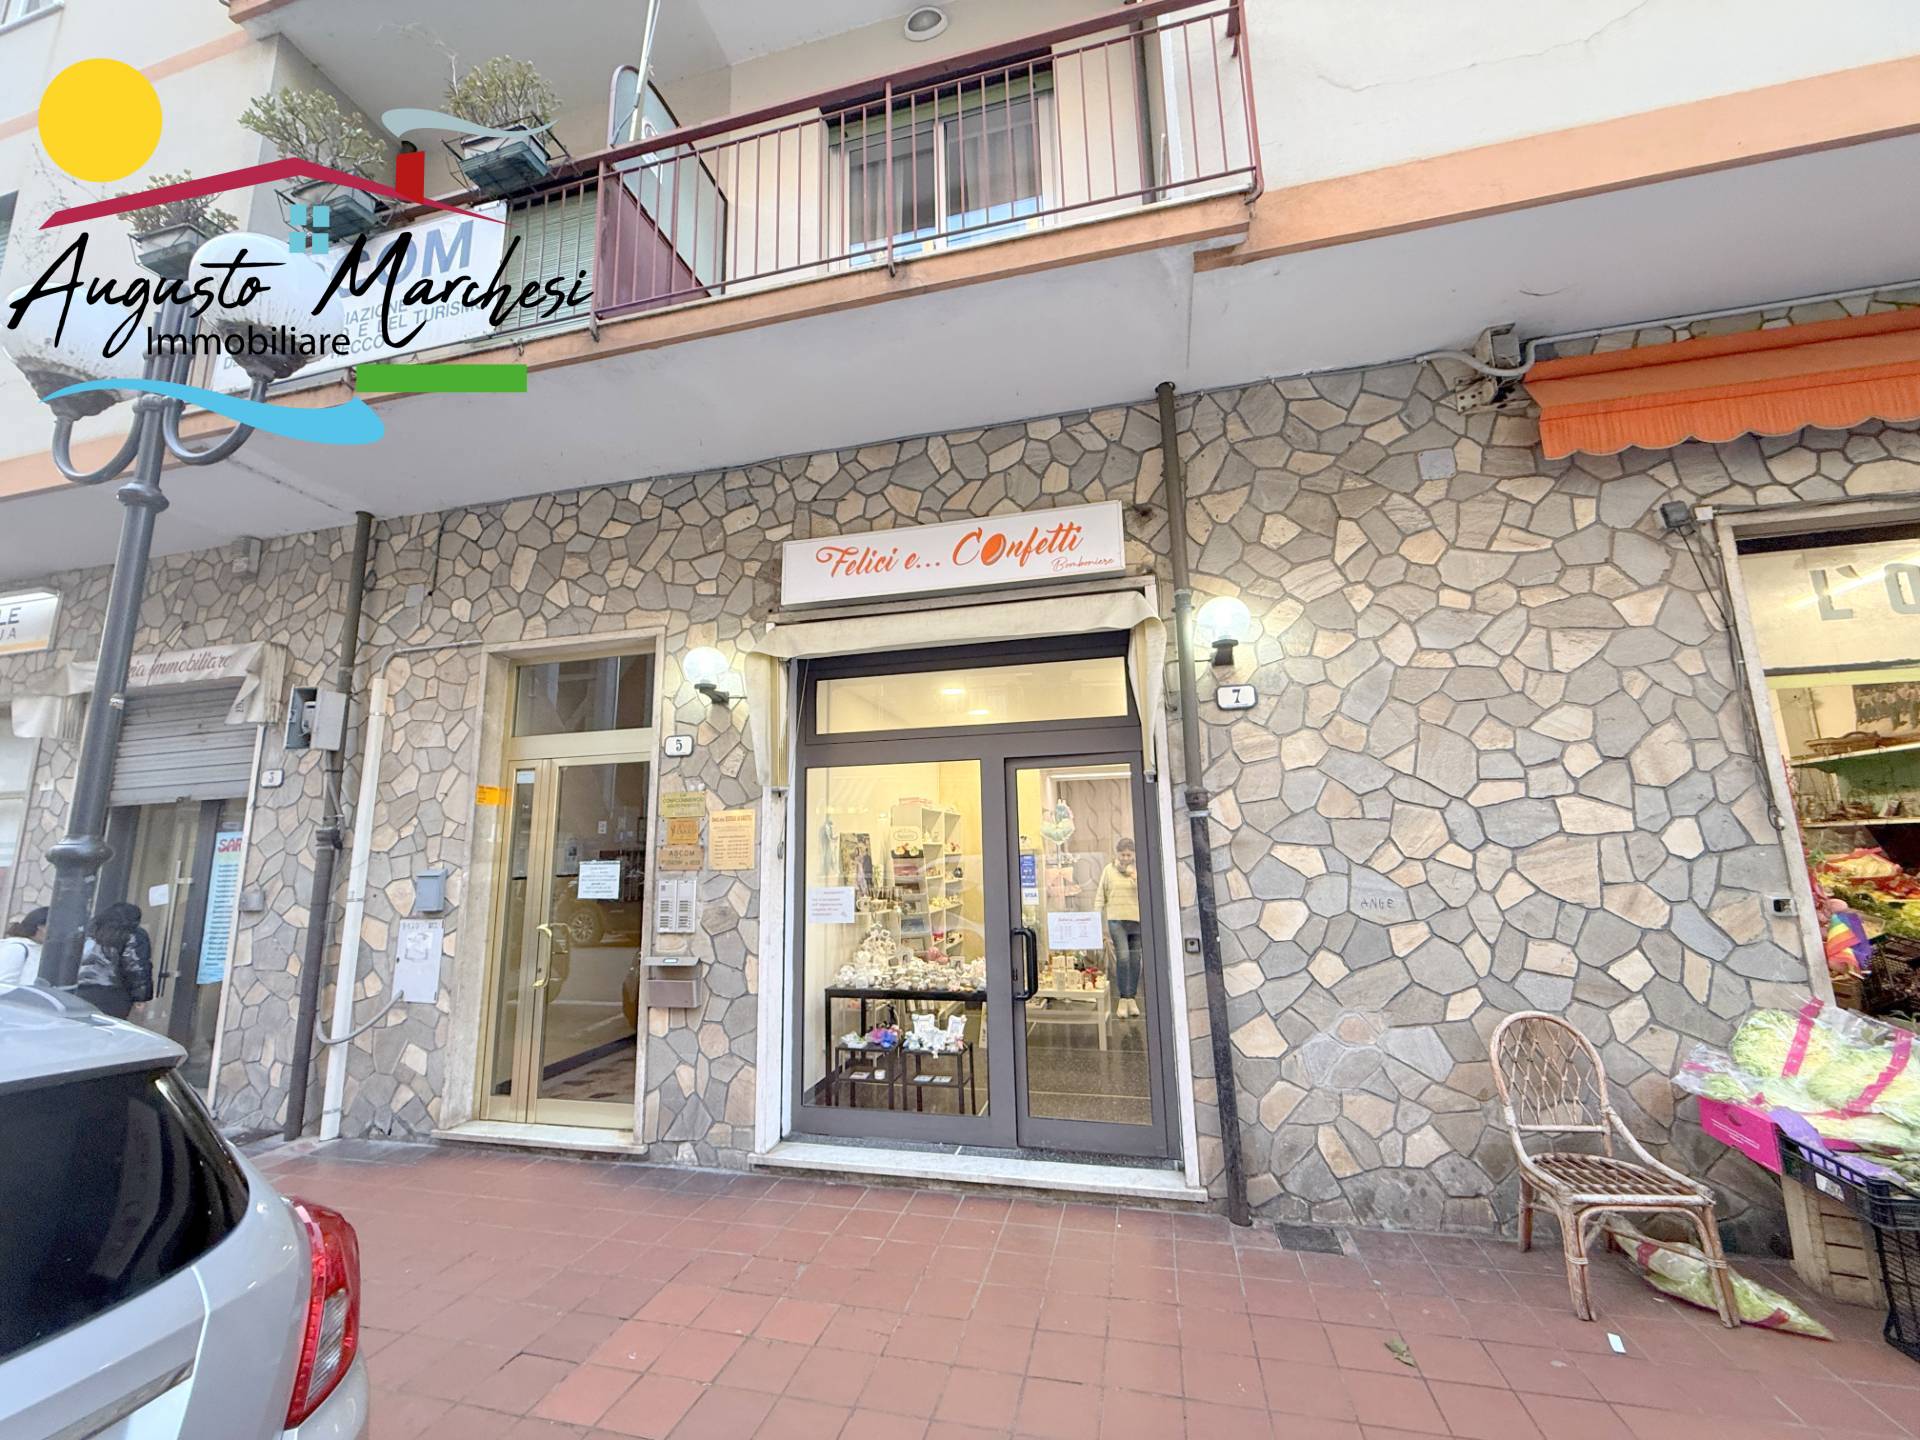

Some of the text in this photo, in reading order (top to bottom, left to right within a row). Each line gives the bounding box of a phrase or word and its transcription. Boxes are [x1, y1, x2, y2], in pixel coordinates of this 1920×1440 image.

[316, 220, 473, 298] COM
[816, 546, 898, 578] Felici
[1231, 688, 1241, 704] 7
[675, 738, 683, 752] 5
